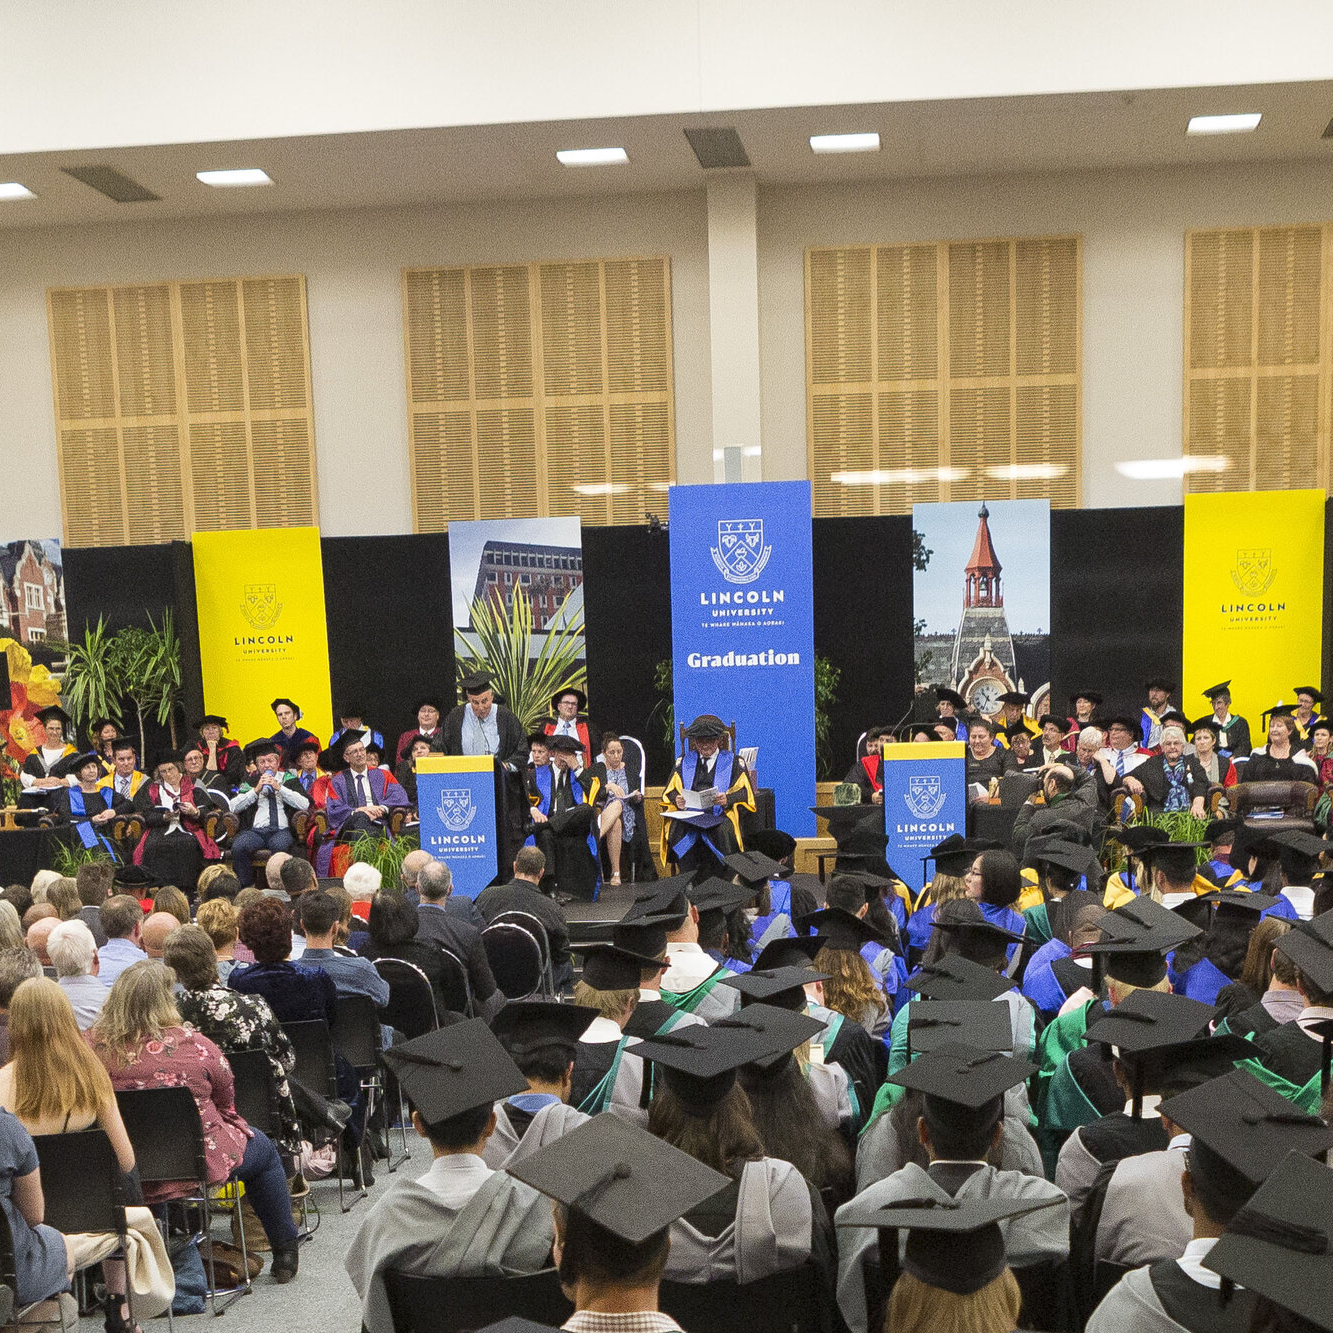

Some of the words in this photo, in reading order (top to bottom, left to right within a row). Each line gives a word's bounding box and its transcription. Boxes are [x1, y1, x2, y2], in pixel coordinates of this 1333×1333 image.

[700, 590, 784, 605] LINCOLN
[711, 608, 774, 617] UNIVERSITY
[1221, 602, 1286, 613] LINCOLN
[234, 635, 293, 646] LINCOLN
[687, 649, 800, 668] Graduation
[896, 822, 955, 833] LINCOLN
[430, 834, 486, 845] LINCOLN
